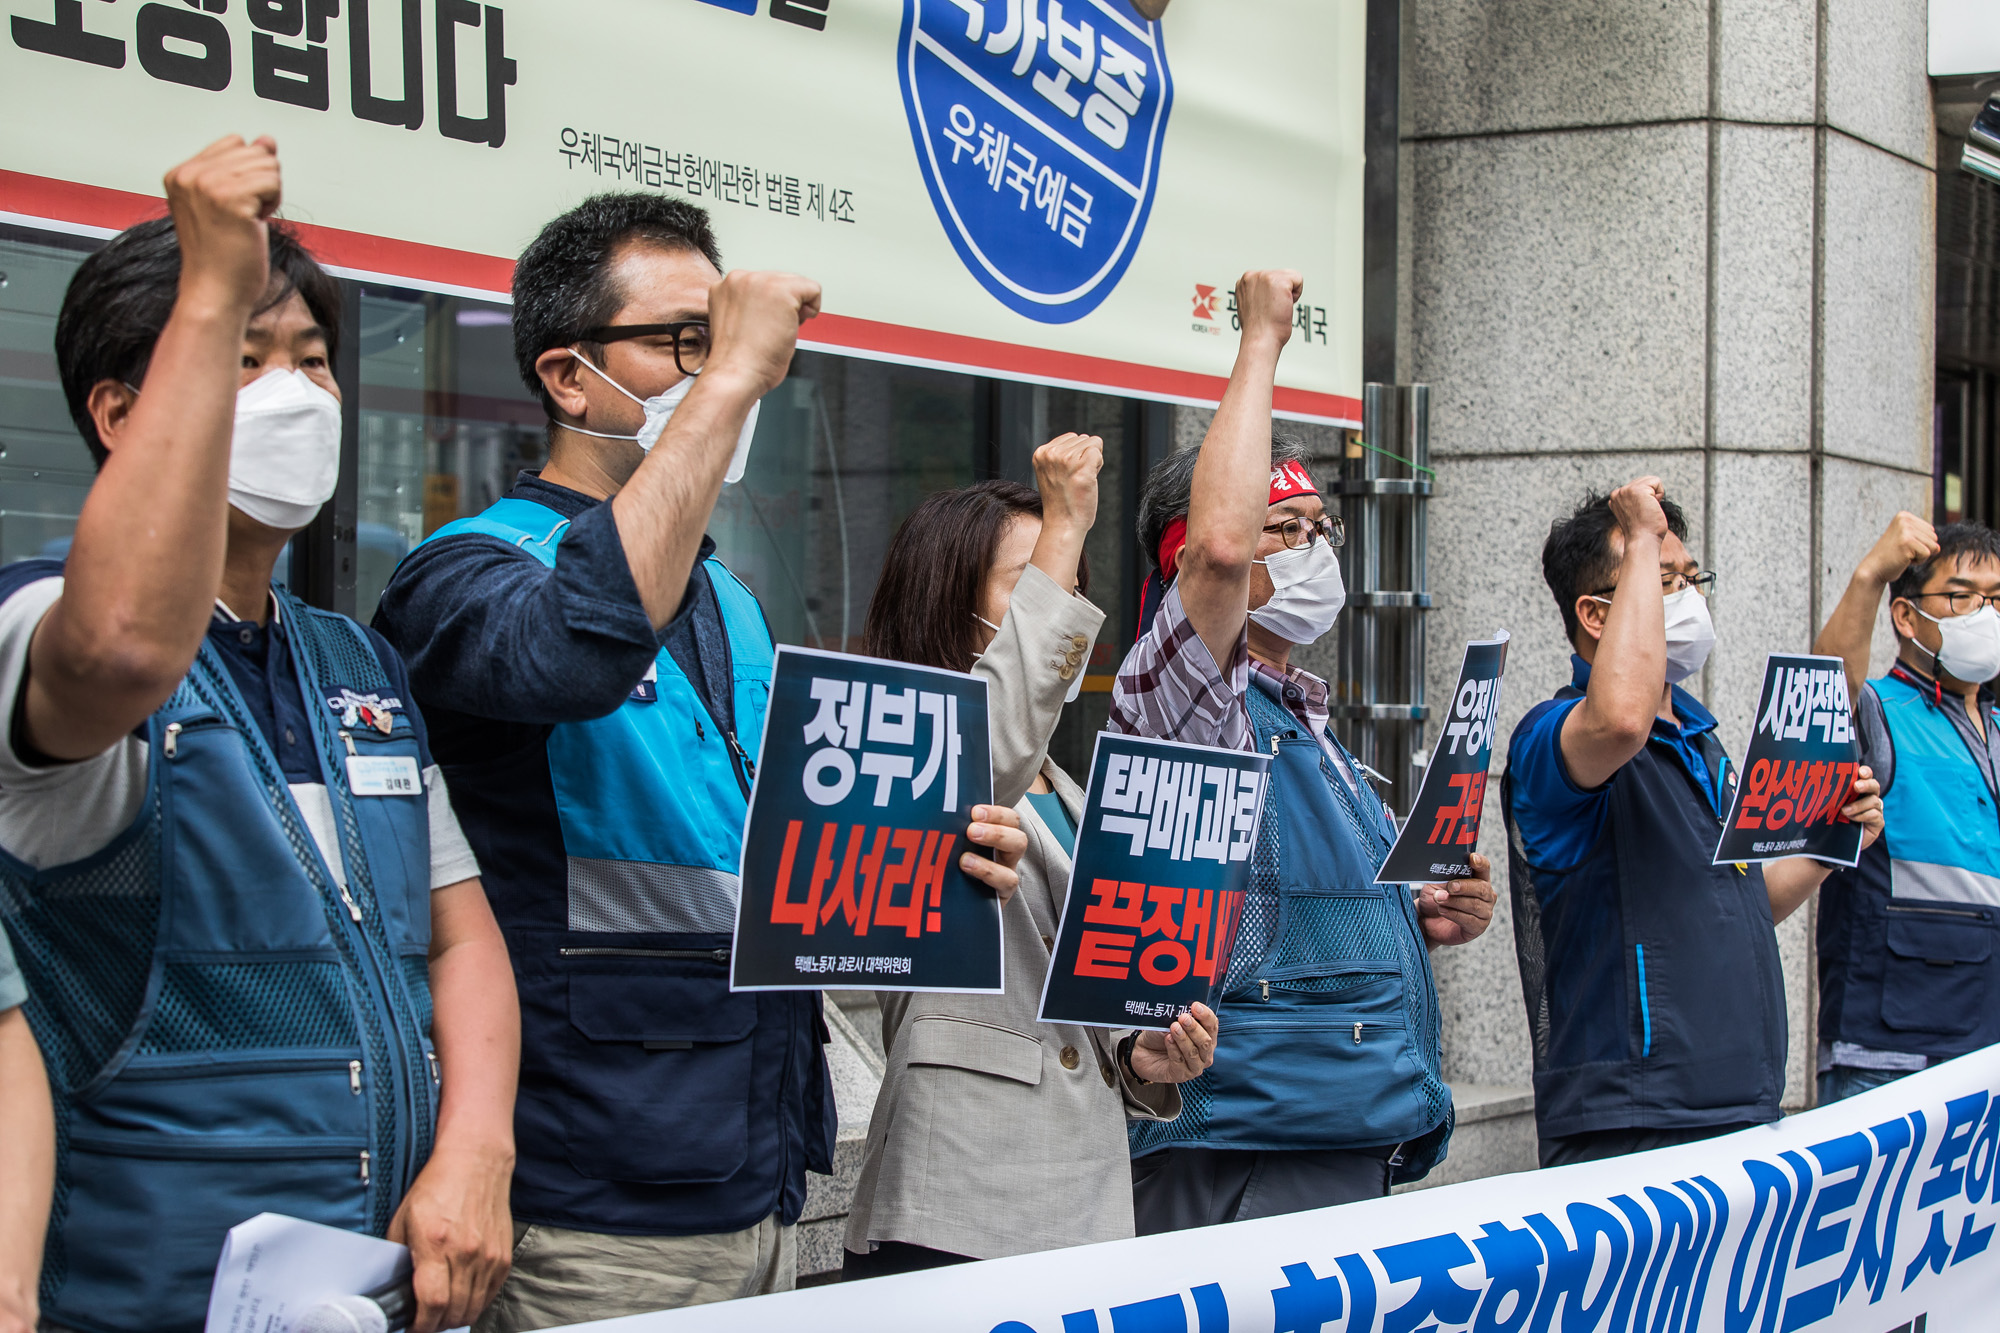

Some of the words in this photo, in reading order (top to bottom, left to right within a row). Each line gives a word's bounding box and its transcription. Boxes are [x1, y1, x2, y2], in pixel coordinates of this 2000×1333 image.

[559, 127, 760, 207] 우체국예금보험에관한
[765, 172, 801, 217] 법률
[943, 104, 1094, 248] 우체국예금
[802, 677, 962, 812] 정부가
[1759, 667, 1856, 743] 사회적합
[1100, 753, 1271, 864] 택배과로
[770, 820, 957, 939] 나서라!
[795, 955, 836, 973] 택배노동자
[836, 956, 864, 973] 과로사
[865, 957, 912, 974] 대책위원회
[1124, 1000, 1175, 1018] 택배노동자
[1724, 1109, 1927, 1333] 이르지
